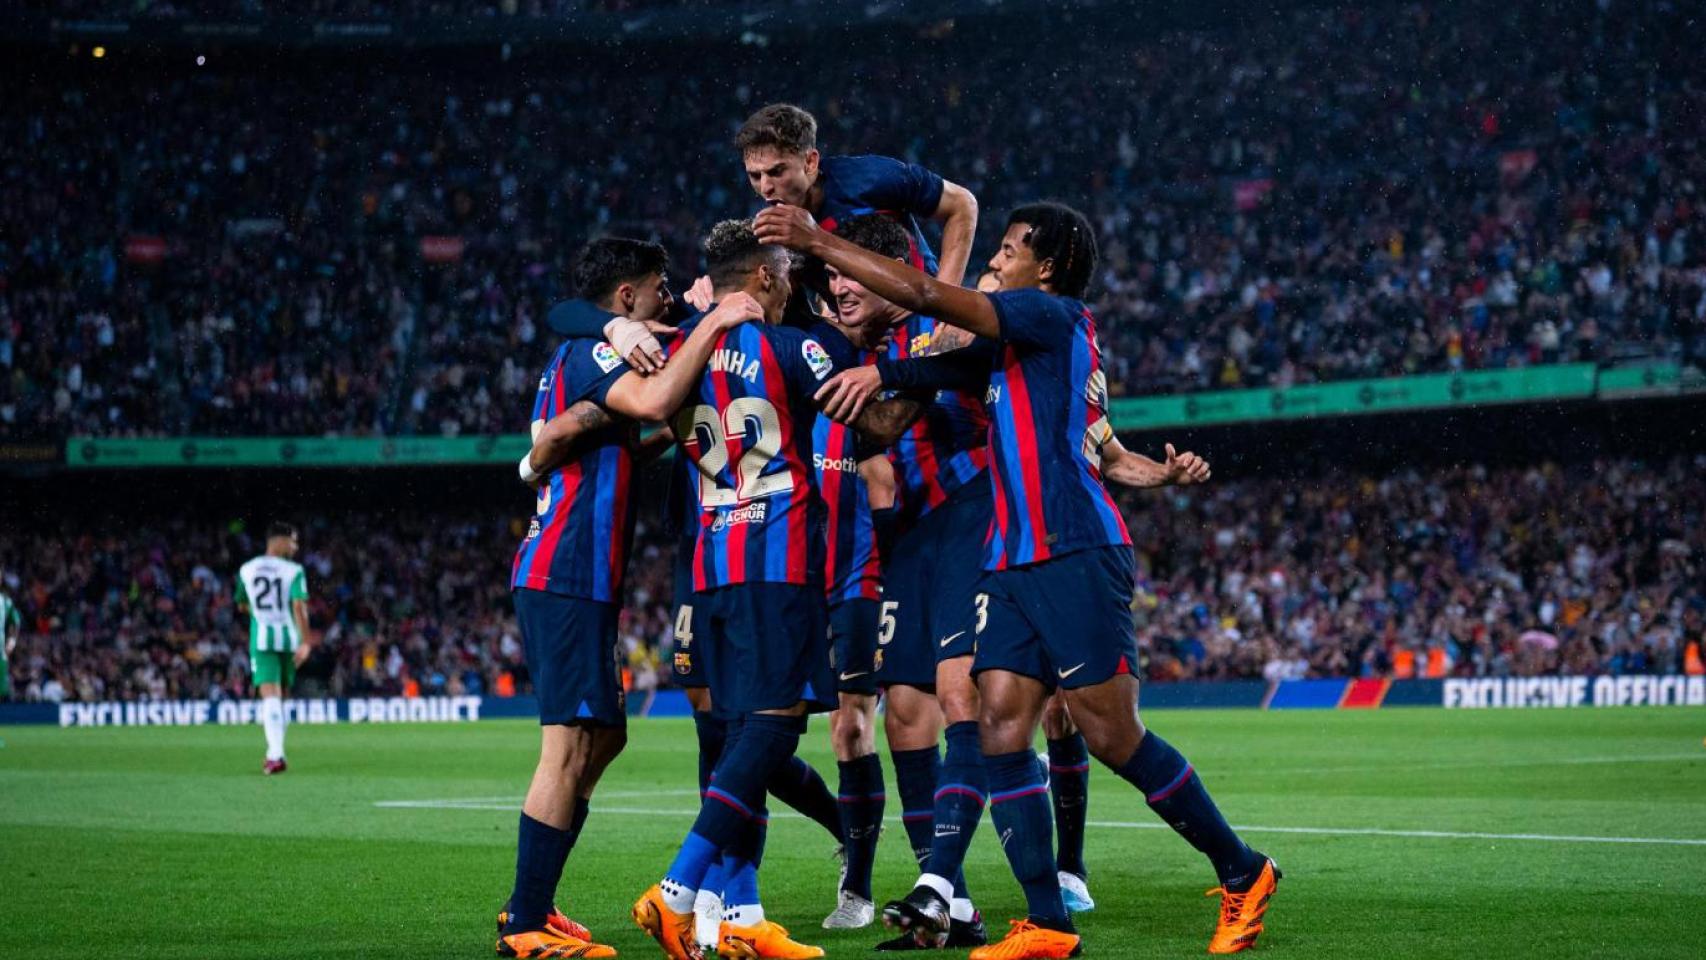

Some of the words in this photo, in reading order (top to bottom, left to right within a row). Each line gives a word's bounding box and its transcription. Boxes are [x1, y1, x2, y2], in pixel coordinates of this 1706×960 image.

[675, 397, 794, 511] 22
[253, 576, 283, 611] 21
[675, 604, 694, 648] 4
[879, 601, 899, 645] 5
[1444, 676, 1588, 708] EXCLUSIVE
[1593, 674, 1706, 706] OFFICIA
[59, 701, 210, 727] EXCLUSIVE
[217, 699, 338, 725] OFFCIAL
[349, 697, 482, 723] PRODUCT
